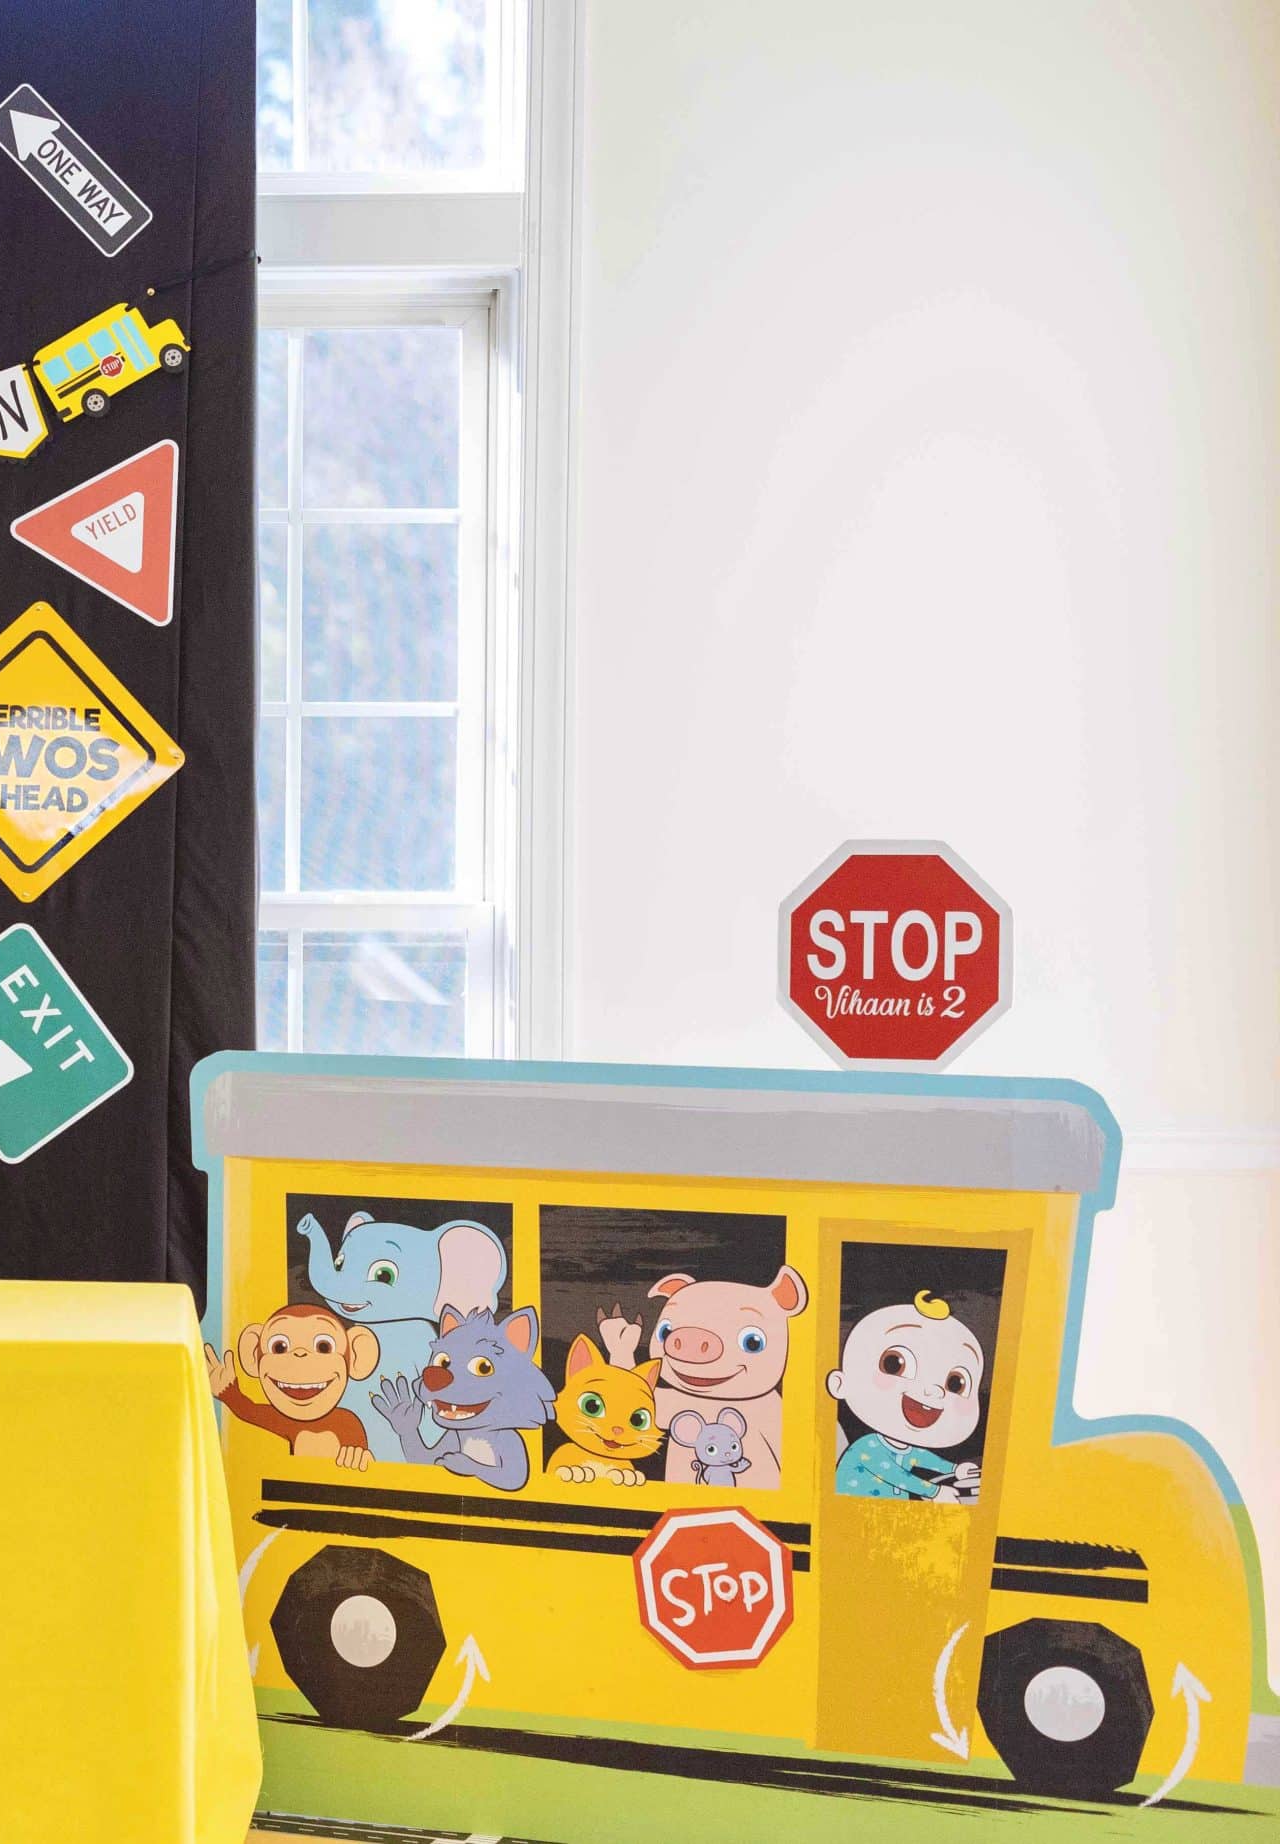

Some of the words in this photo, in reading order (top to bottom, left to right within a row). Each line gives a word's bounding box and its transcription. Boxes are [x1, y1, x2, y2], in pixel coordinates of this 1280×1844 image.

[37, 139, 82, 185] ONE
[77, 179, 124, 224] WAY
[102, 359, 120, 374] STOP
[85, 503, 137, 540] YIELD
[807, 909, 983, 981] STOP
[0, 964, 96, 1071] EXIT
[814, 985, 911, 1020] Vihaan
[916, 992, 936, 1017] is
[940, 986, 967, 1019] 2
